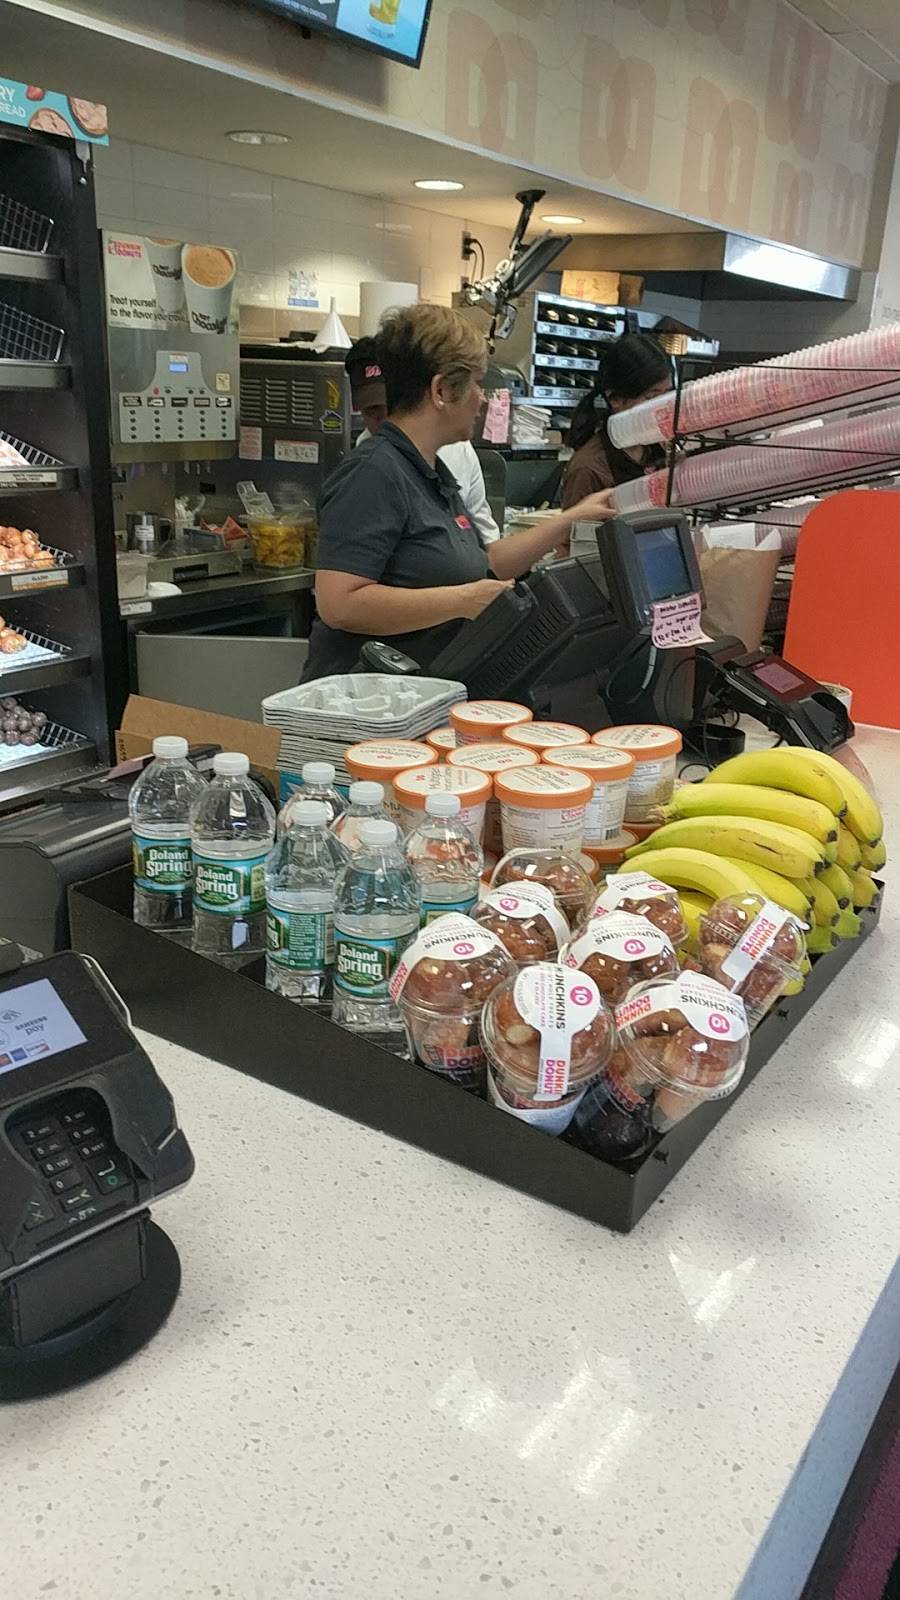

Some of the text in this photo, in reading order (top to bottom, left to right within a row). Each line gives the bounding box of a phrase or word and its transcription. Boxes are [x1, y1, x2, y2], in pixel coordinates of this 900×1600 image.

[110, 294, 156, 308] Treat yourself
[110, 308, 118, 317] to
[119, 308, 131, 318] the
[132, 309, 153, 320] flavor
[149, 849, 188, 861] Poland
[146, 860, 193, 878] Spring
[197, 866, 233, 882] Poland
[195, 878, 239, 900] Spring
[424, 933, 493, 949] MUNCHKINS
[594, 931, 662, 945] MUNCHKINS
[741, 918, 769, 954] DONUTS
[339, 943, 378, 961] Poland
[455, 944, 474, 954] 10
[626, 941, 645, 953] 10
[337, 955, 384, 980] Spring
[574, 988, 590, 1003] 10
[25, 1024, 45, 1036] pay
[711, 1017, 729, 1030] 10
